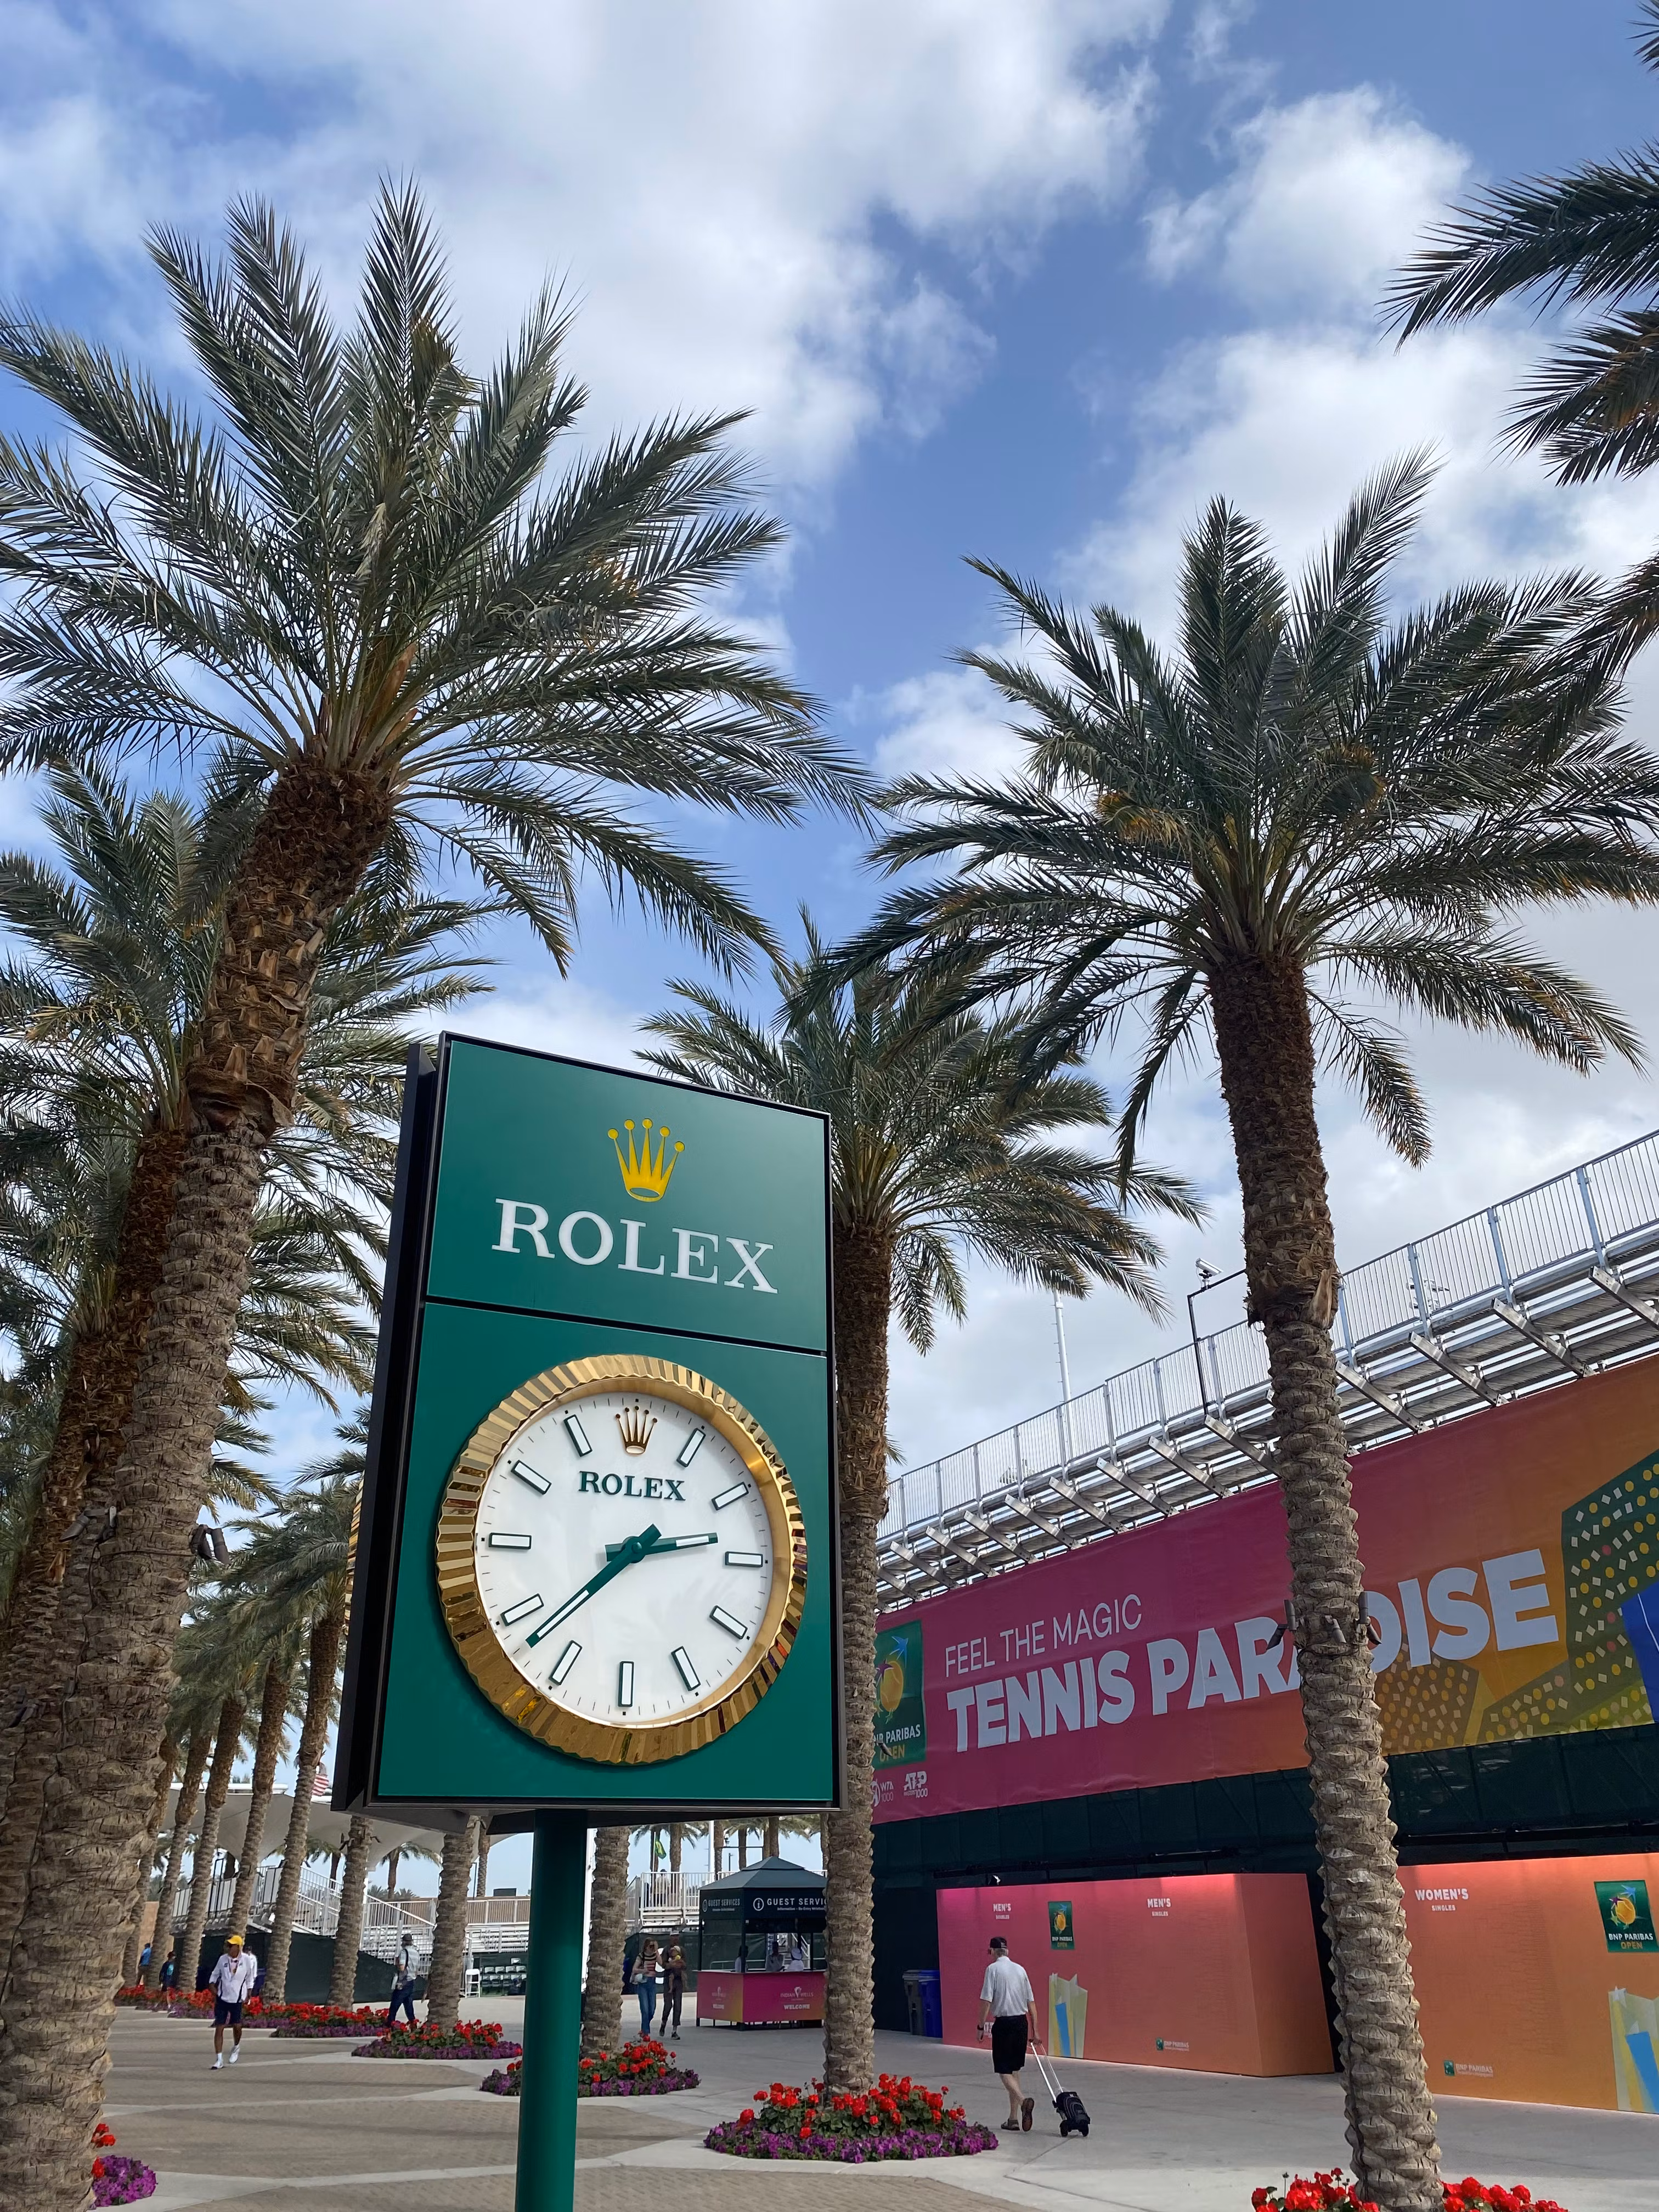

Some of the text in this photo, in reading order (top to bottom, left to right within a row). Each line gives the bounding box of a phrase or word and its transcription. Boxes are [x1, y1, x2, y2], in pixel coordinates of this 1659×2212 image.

[491, 1198, 778, 1294] ROLEX
[578, 1471, 686, 1501] ROLEX
[945, 1594, 1142, 1678] FEEL THE MAGIC
[947, 1650, 1135, 1752] TENNIS
[885, 1724, 921, 1744] PARIBAS
[880, 1781, 894, 1792] WTA
[904, 1770, 927, 1791] ATP
[881, 1792, 894, 1803] 1000
[915, 1787, 928, 1798] 1000
[1414, 1888, 1469, 1900] WOMEN'S
[993, 1903, 1012, 1912] MEN'S
[1147, 1898, 1171, 1908] MEN'S
